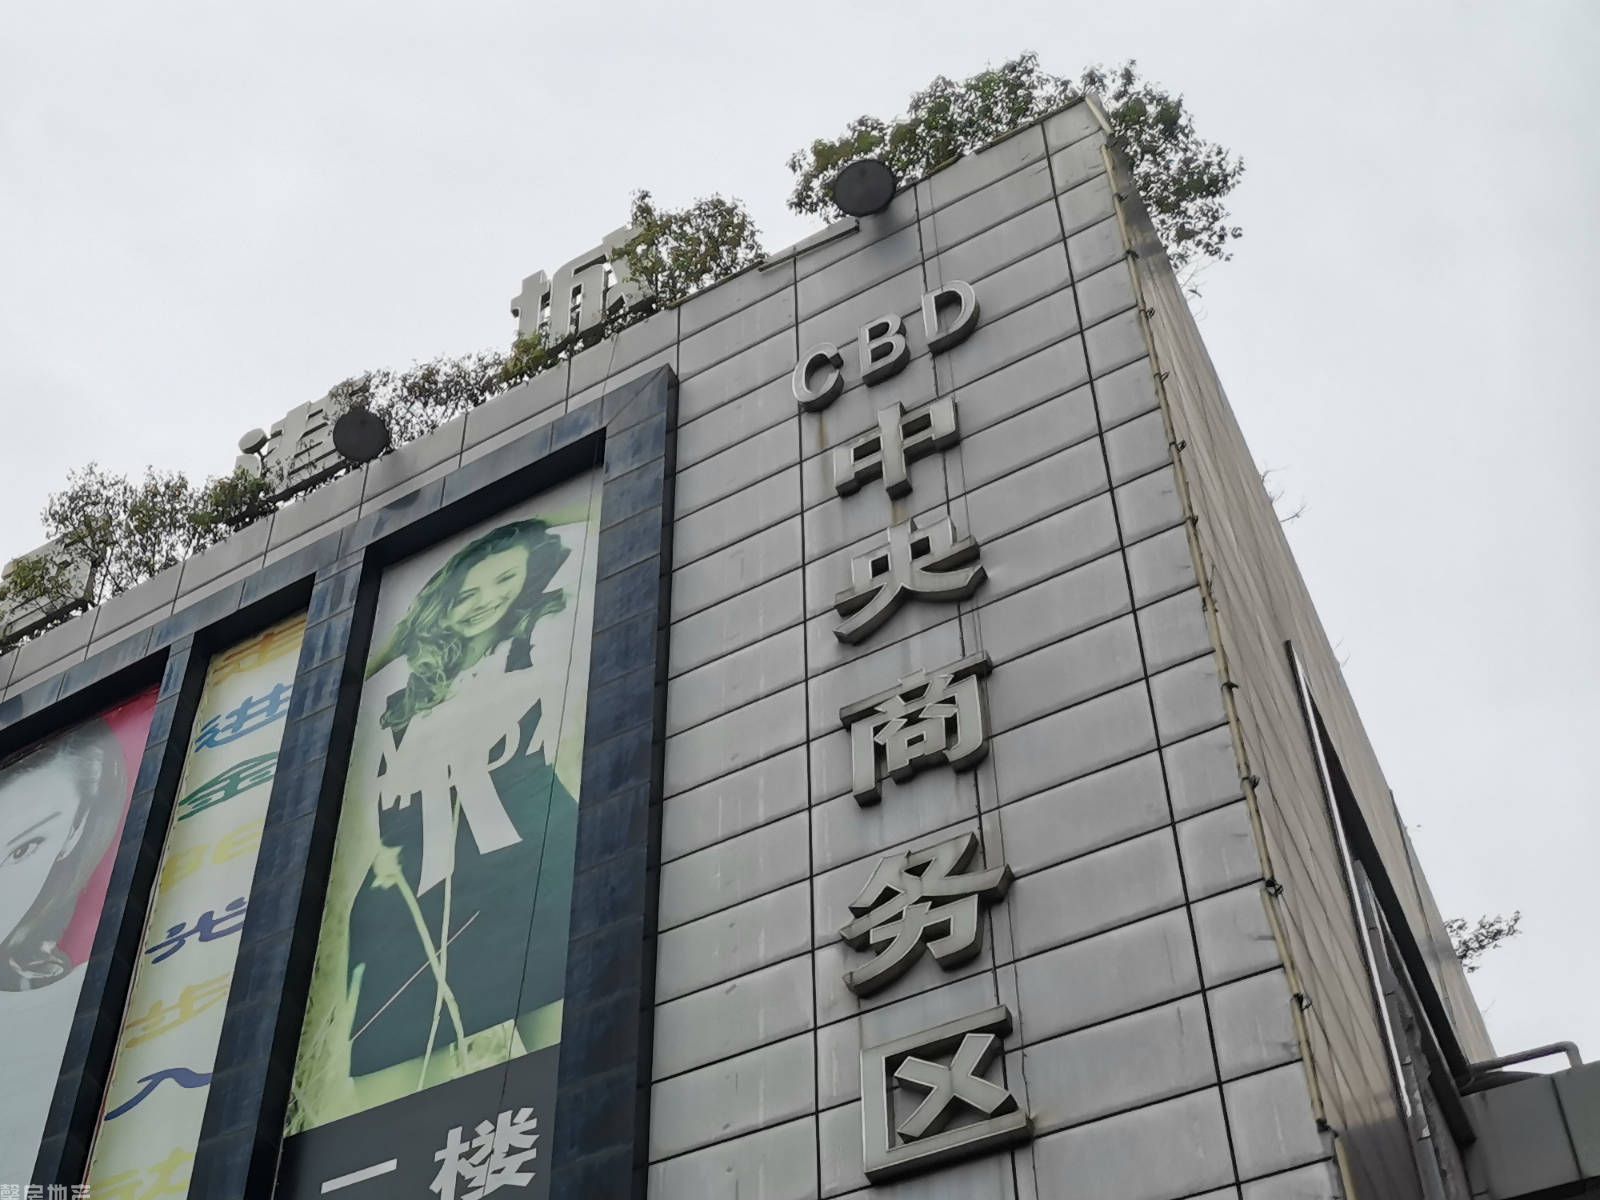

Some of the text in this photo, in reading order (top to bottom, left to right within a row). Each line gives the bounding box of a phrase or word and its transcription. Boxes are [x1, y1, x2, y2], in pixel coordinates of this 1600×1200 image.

[792, 280, 981, 412] CBD
[832, 397, 1035, 1186] 中央商务区
